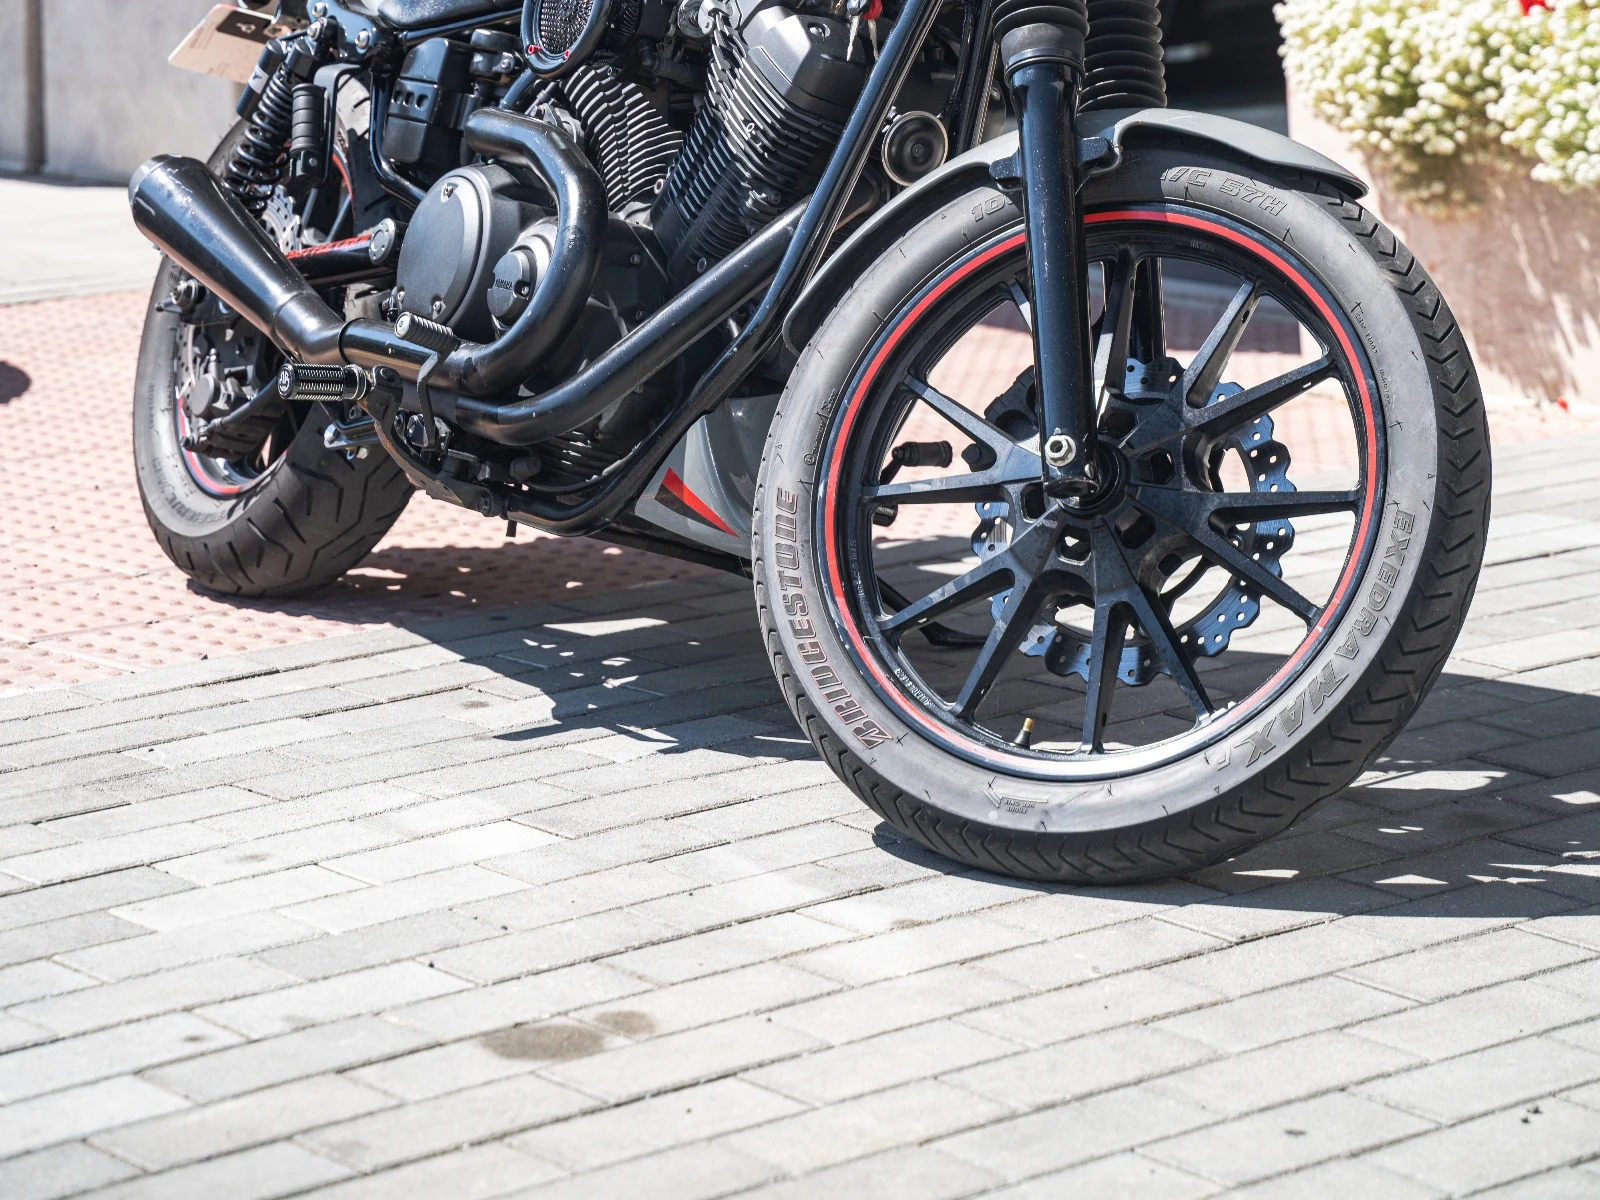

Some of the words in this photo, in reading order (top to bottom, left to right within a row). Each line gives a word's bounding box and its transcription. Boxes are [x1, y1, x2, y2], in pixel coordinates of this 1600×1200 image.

[1219, 177, 1288, 217] 57H
[773, 487, 893, 749] BRIDGESTONE
[1335, 509, 1415, 660] EXEDRA
[1234, 659, 1349, 767] MAX
